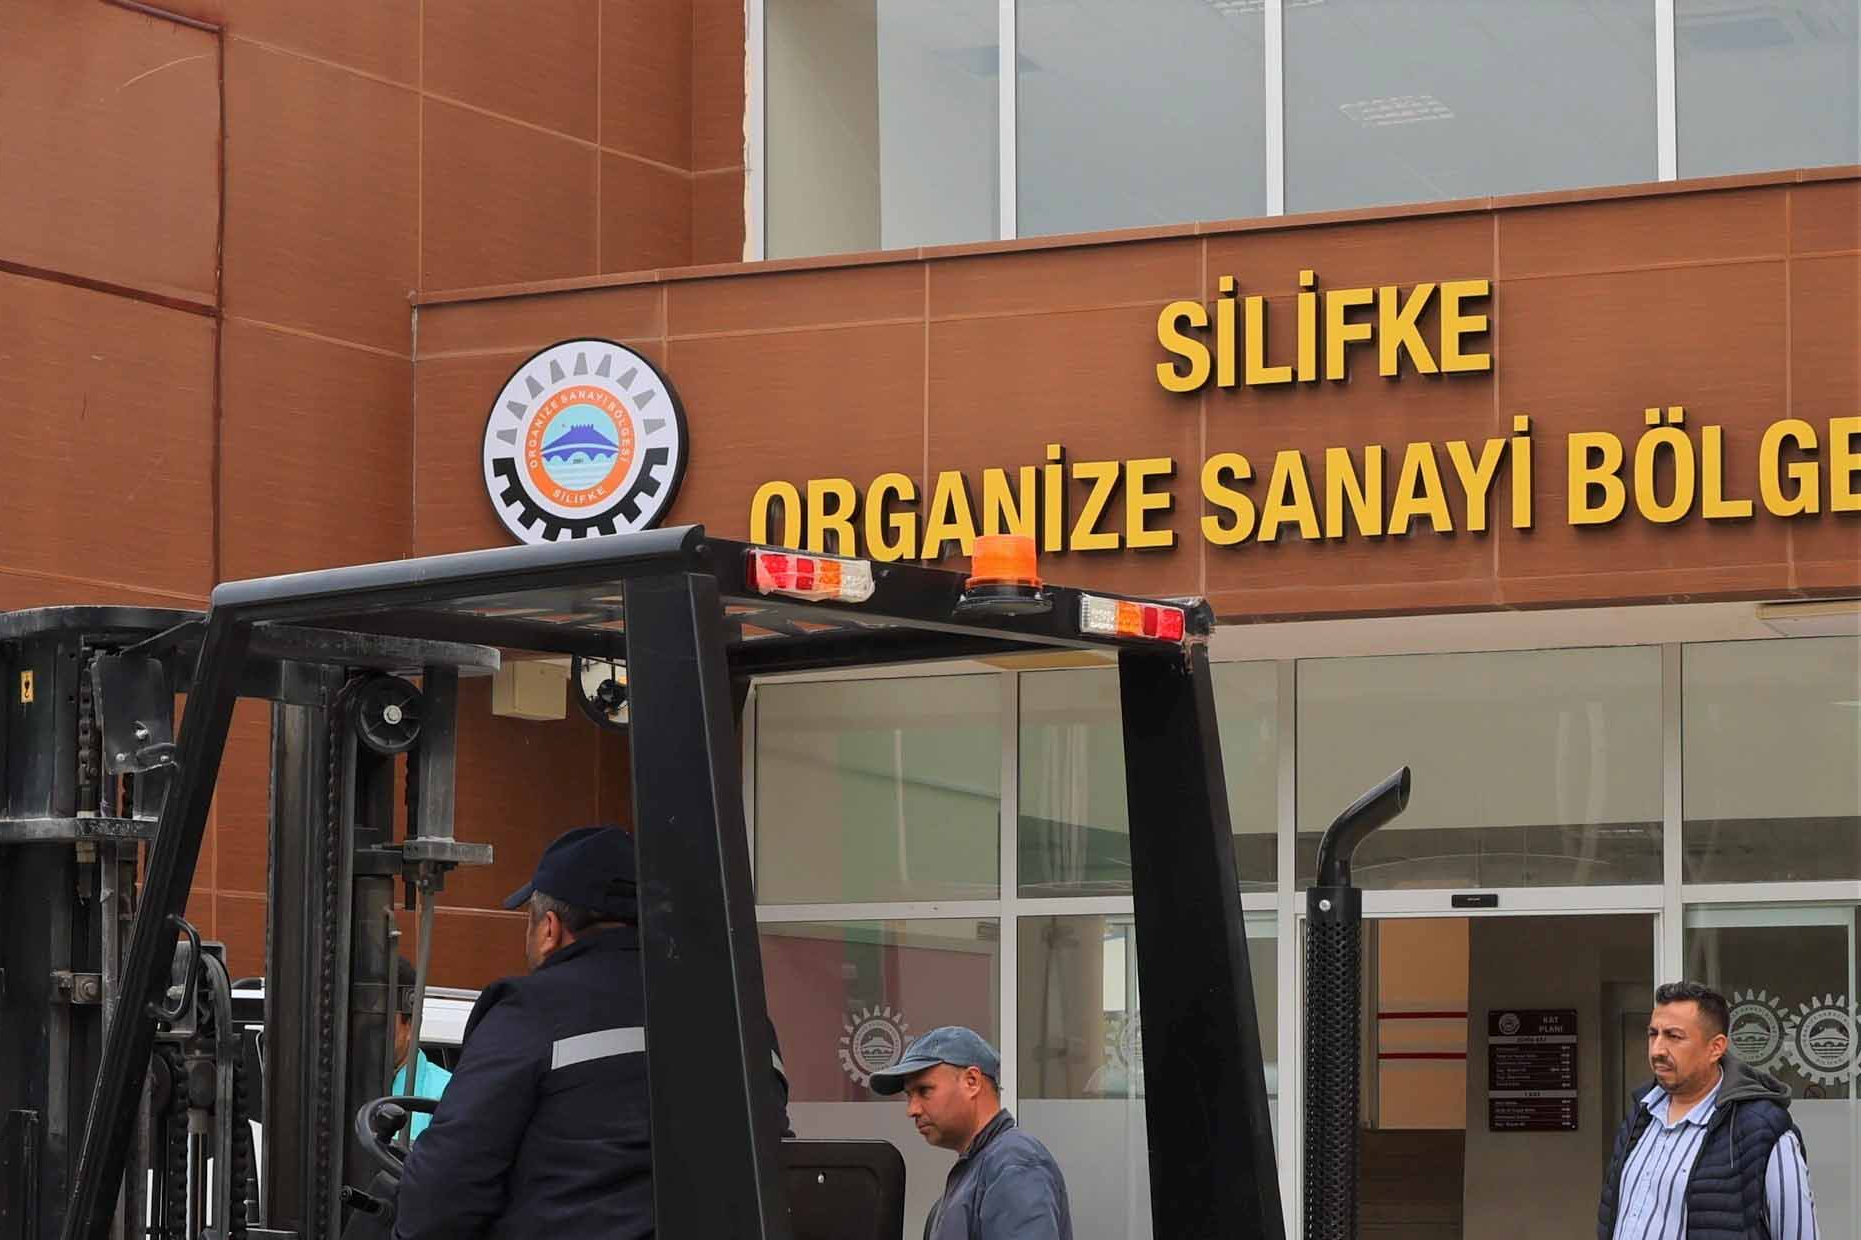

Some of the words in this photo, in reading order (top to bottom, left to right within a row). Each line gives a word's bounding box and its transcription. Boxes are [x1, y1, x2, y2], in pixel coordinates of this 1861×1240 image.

[1156, 270, 1491, 393] SİLİFKE
[749, 443, 1174, 562] ORGANİZE
[1200, 415, 1531, 545] SANAYİ
[1568, 406, 1861, 526] BÖLGE
